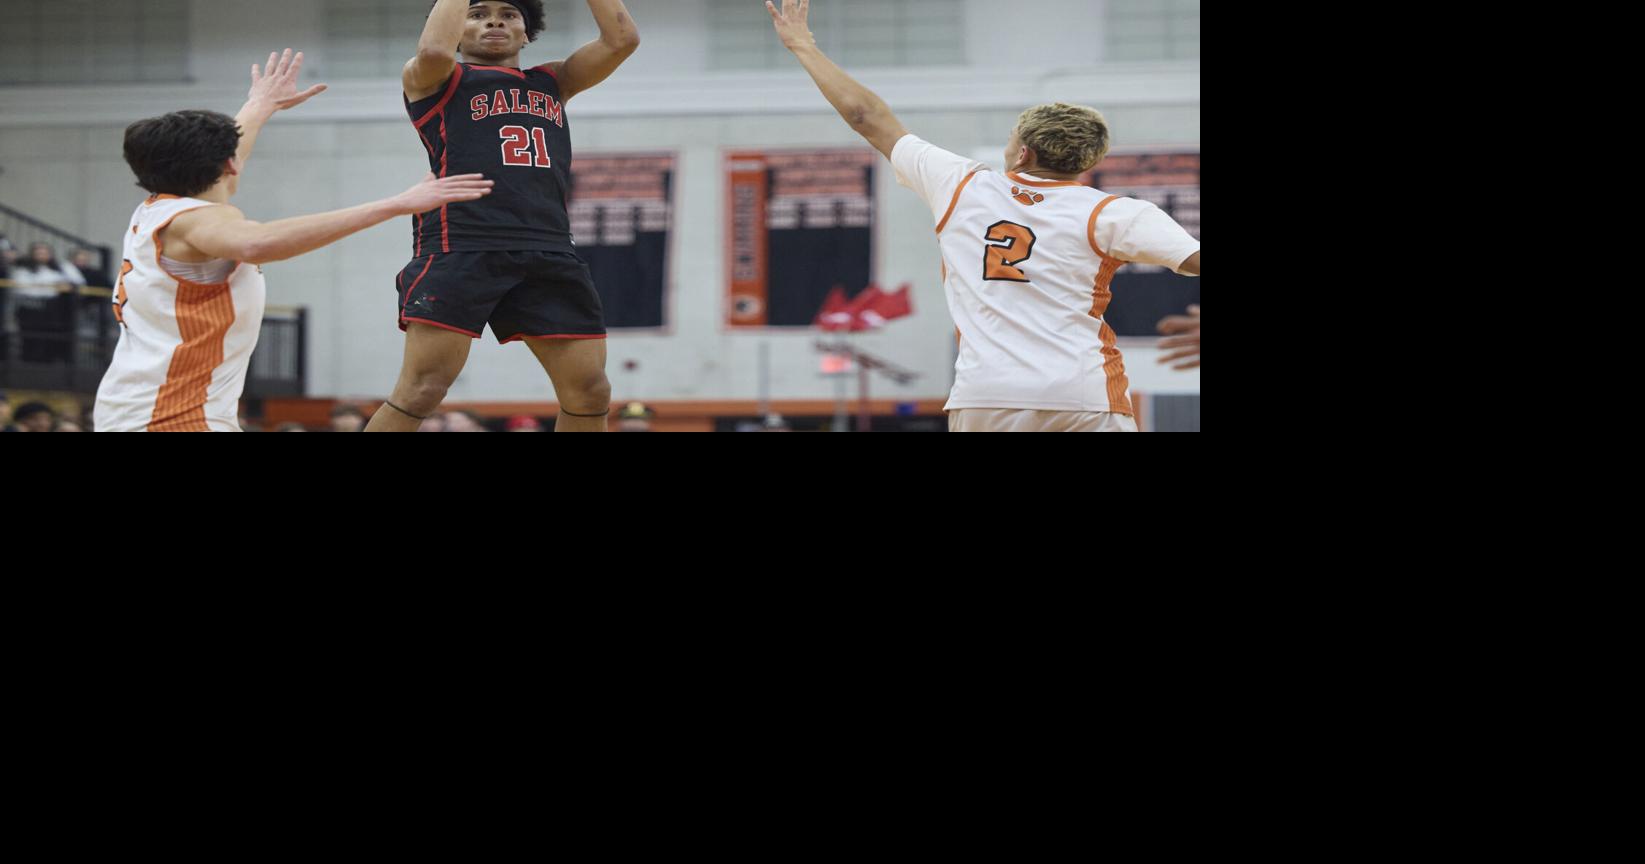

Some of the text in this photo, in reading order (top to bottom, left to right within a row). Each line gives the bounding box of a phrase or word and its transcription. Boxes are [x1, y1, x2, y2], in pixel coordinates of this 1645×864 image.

[470, 89, 563, 127] SALEM
[499, 124, 551, 168] 21
[983, 220, 1037, 283] 2
